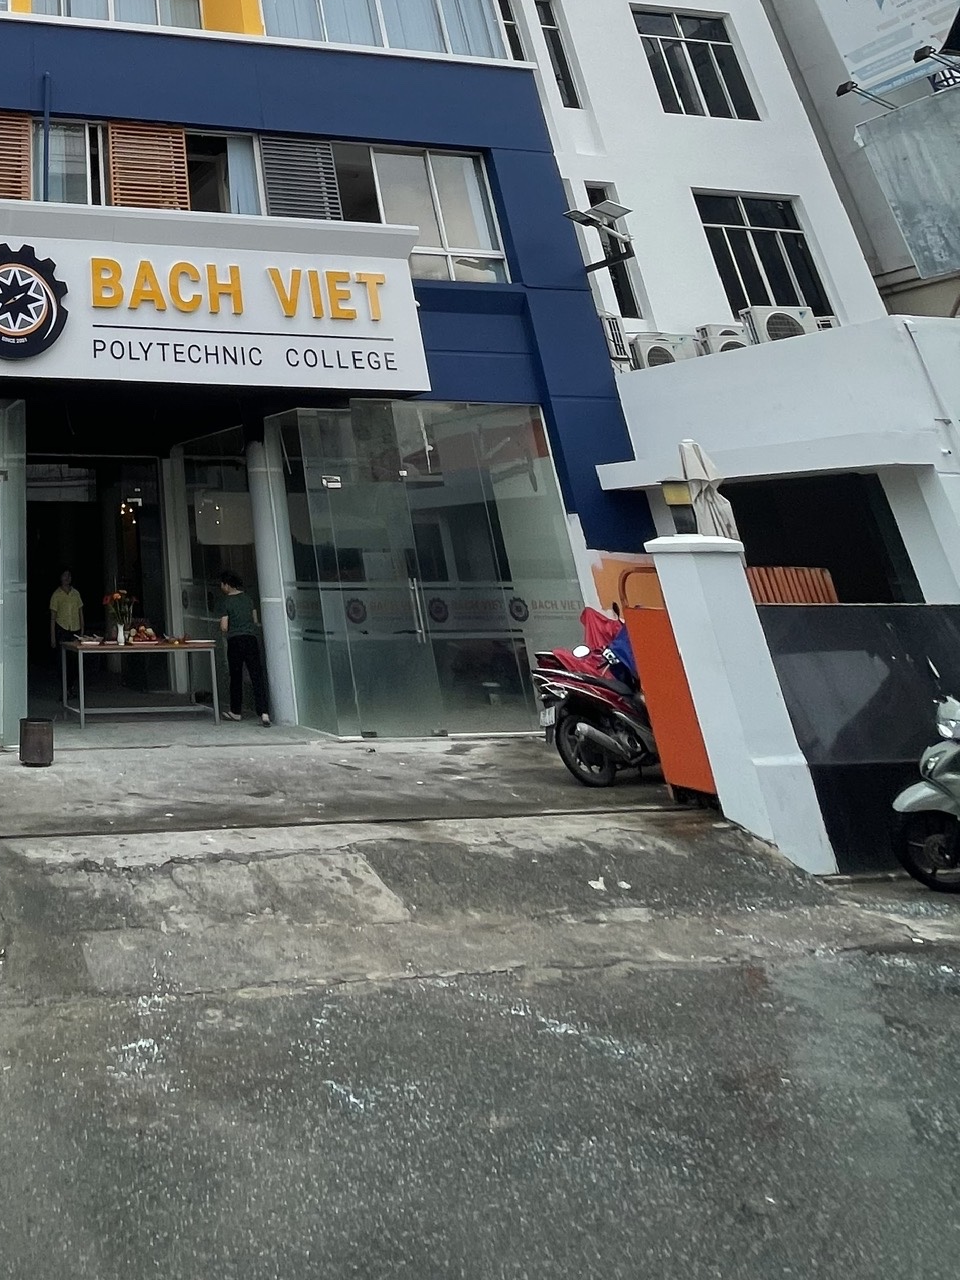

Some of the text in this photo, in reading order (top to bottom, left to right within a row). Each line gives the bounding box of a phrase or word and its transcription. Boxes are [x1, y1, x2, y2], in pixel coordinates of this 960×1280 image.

[89, 257, 387, 322] BACH VIET
[92, 339, 399, 371] POLYTECHNIC COLLEGE
